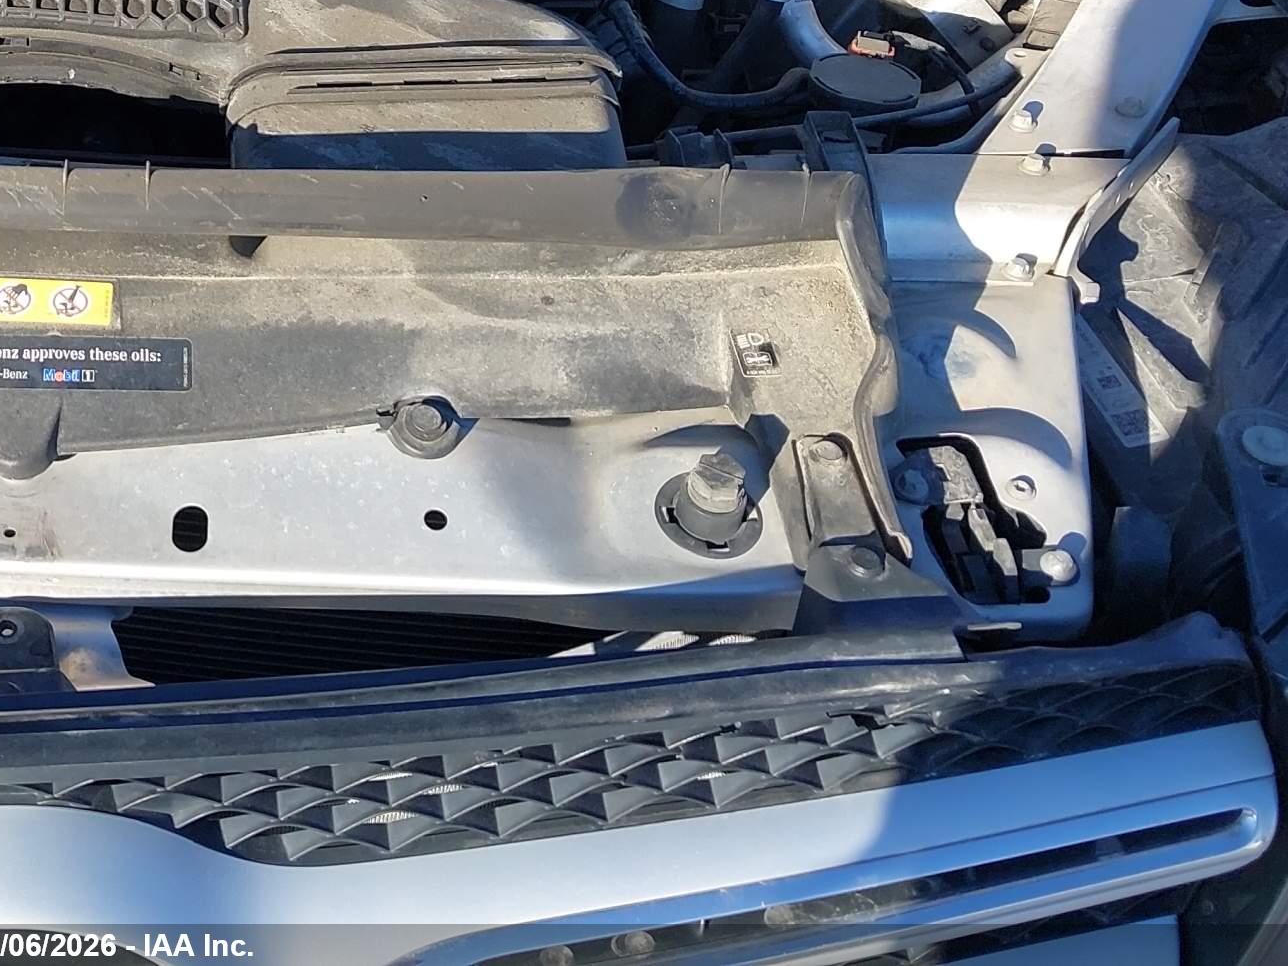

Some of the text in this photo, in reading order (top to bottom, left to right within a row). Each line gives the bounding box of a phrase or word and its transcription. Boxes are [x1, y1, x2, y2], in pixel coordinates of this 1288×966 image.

[22, 348, 86, 363] approves
[89, 347, 128, 361] these
[131, 348, 162, 362] oils:
[43, 368, 81, 382] Mobil
